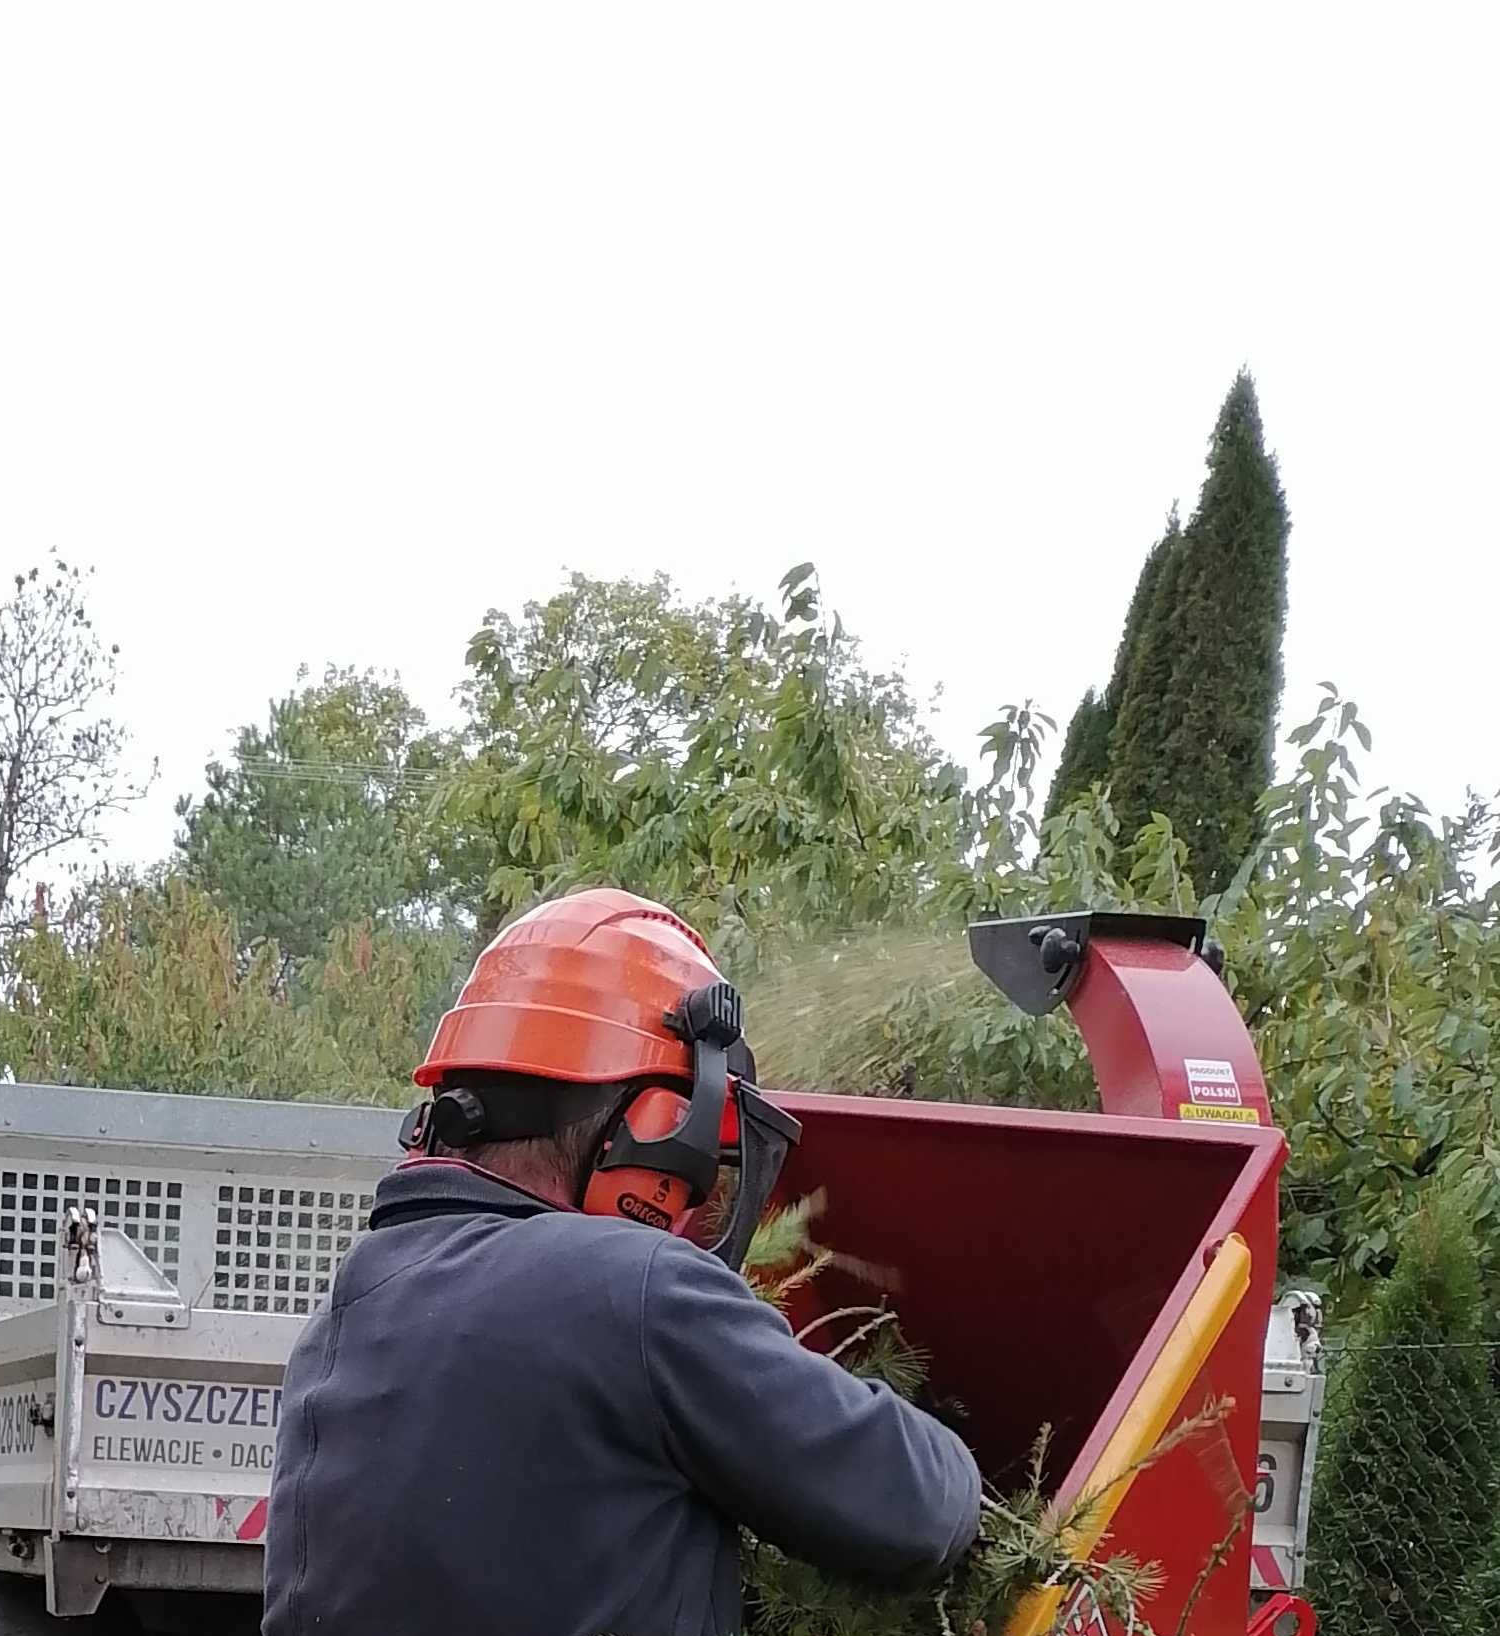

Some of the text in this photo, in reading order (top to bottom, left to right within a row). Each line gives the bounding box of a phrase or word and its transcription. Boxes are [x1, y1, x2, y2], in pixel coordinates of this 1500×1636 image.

[1193, 1086, 1237, 1099] POLSKI
[1195, 1107, 1244, 1121] UWAGA!
[621, 1196, 669, 1229] OREGON
[93, 1435, 205, 1465] ELEWACJE
